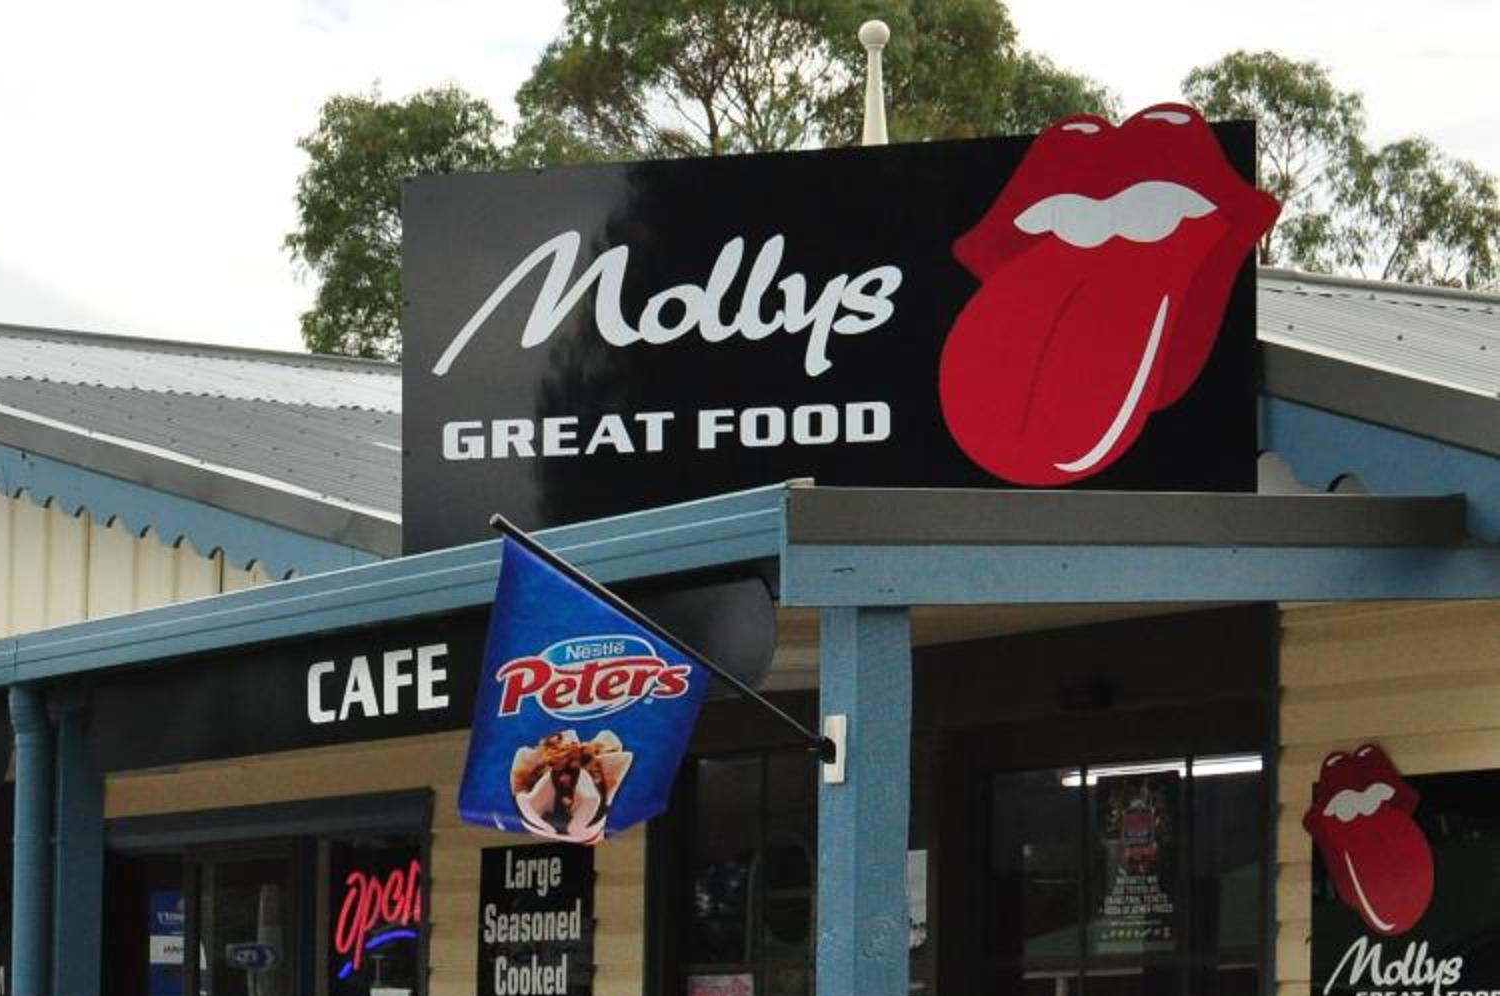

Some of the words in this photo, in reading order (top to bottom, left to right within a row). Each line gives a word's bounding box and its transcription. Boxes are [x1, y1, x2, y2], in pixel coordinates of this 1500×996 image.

[432, 231, 902, 376] Mollys
[442, 410, 675, 461] GREAT
[697, 401, 891, 450] FOOD
[305, 643, 450, 725] CAFE
[496, 656, 692, 717] Peters
[505, 850, 561, 897] Large
[484, 899, 581, 944] Seasoned
[494, 954, 568, 996] Cooked
